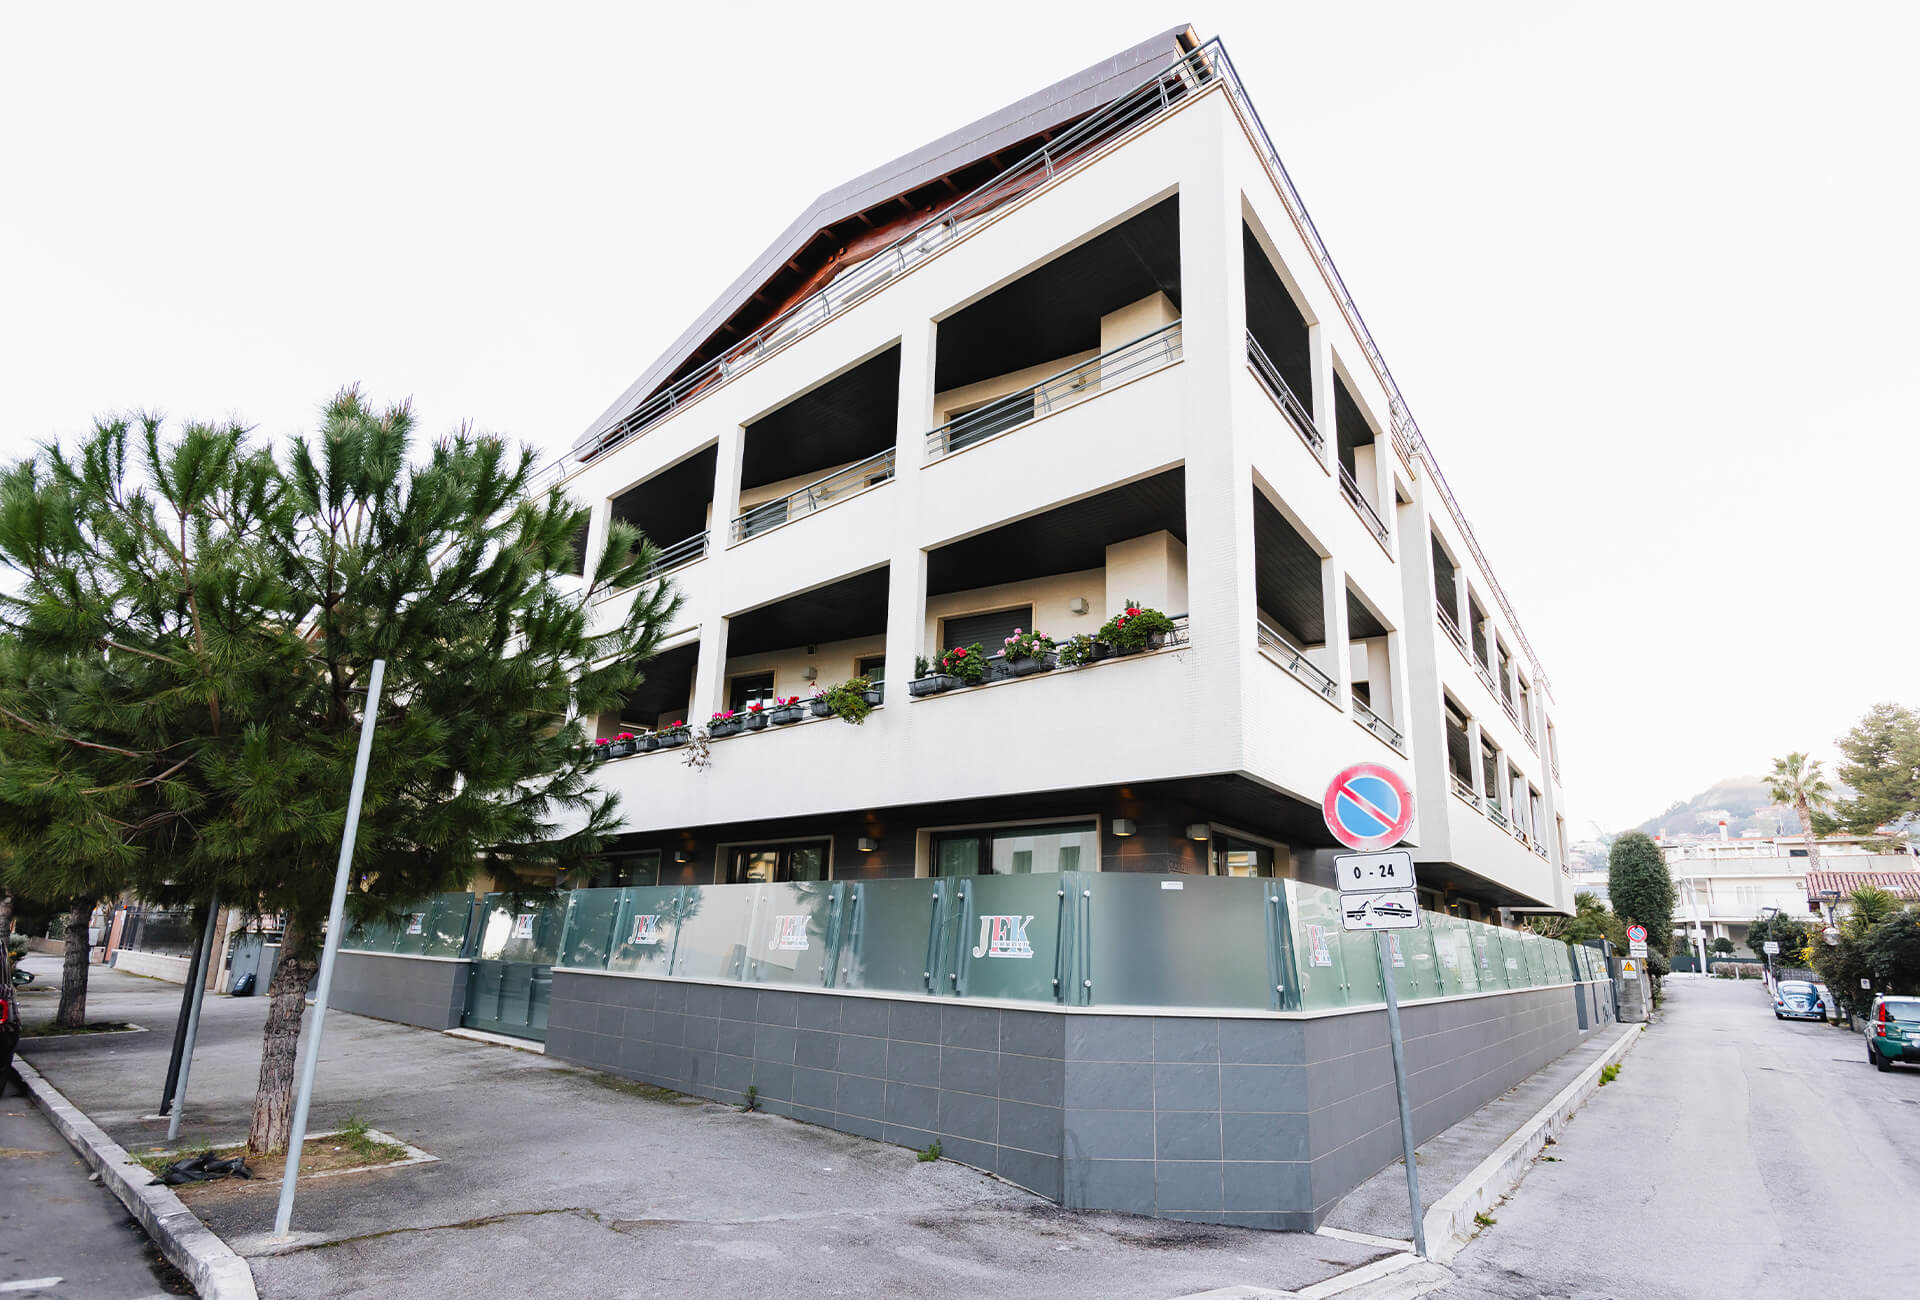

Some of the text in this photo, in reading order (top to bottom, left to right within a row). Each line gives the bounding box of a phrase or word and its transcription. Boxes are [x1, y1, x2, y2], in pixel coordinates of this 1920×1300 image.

[1353, 866, 1362, 880] 0
[1378, 863, 1395, 878] 24
[972, 915, 1034, 958] JFK
